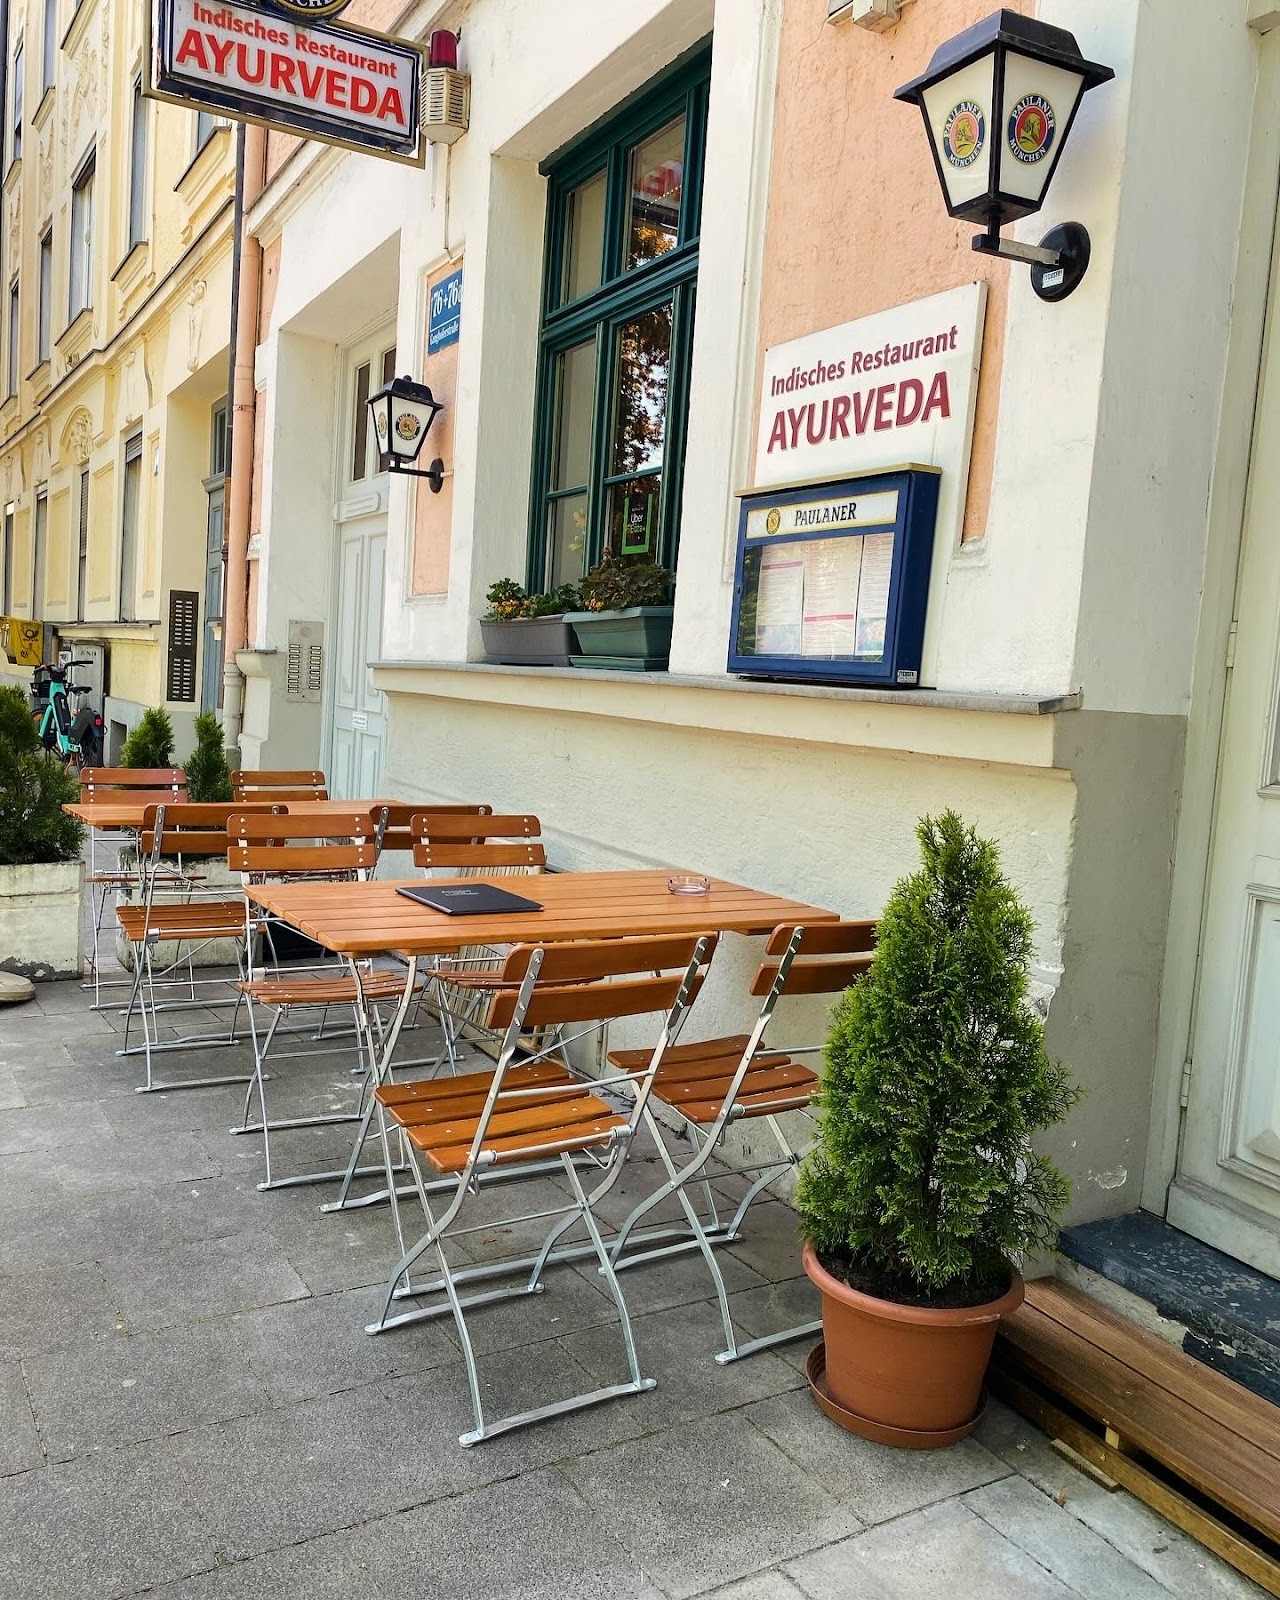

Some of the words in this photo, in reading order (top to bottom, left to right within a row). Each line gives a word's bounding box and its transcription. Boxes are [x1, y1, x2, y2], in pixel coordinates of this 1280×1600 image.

[175, 28, 405, 125] AYURVEDA
[193, 3, 289, 46] Indisches
[295, 33, 397, 79] Restaurant
[944, 102, 982, 138] PAULANER
[1012, 95, 1054, 128] PAULANER
[771, 360, 846, 397] Indisches
[851, 325, 958, 375] Restaurant
[767, 371, 951, 454] AYURVEDA
[794, 502, 857, 526] PAULANER
